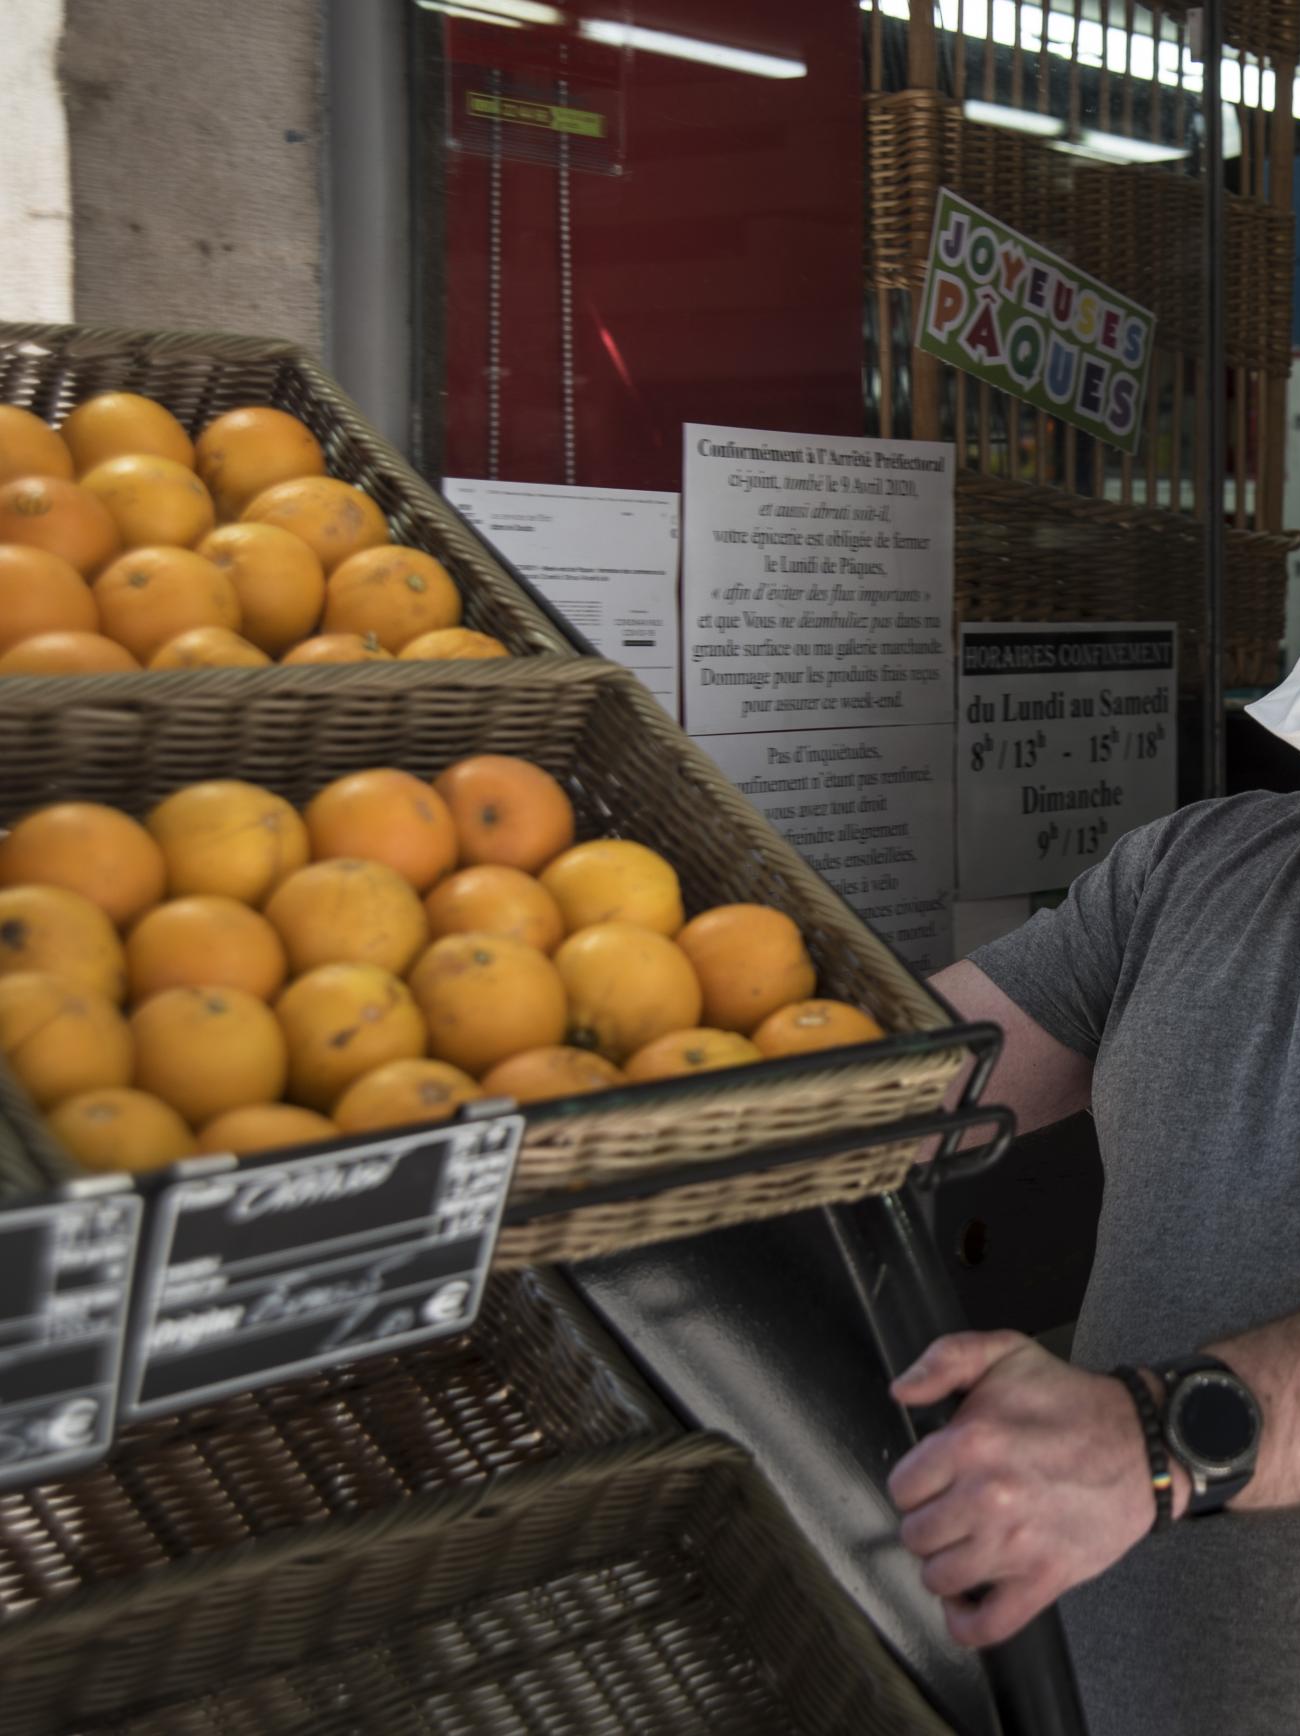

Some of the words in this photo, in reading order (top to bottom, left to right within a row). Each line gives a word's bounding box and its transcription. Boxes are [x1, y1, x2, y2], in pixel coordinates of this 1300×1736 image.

[940, 213, 1147, 367] JOYEUSES
[928, 270, 1139, 436] PÂQUES
[698, 439, 804, 464] Conformément
[807, 447, 816, 463] à
[875, 452, 945, 472] Préfectoral
[825, 475, 838, 492] le
[840, 476, 848, 493] 9
[853, 478, 883, 495] Avril
[758, 504, 772, 517] et
[712, 529, 748, 544] votre
[751, 527, 803, 549] épicerie
[804, 532, 825, 546] est
[827, 530, 872, 552] obligée
[875, 531, 892, 548] de
[893, 531, 931, 549] fermer
[764, 555, 778, 572] le
[780, 556, 818, 574] Lundi
[821, 557, 837, 574] de
[723, 582, 750, 604] afin
[807, 584, 827, 601] des
[829, 584, 855, 605] flux
[858, 587, 921, 606] importants
[697, 613, 712, 629] et
[714, 614, 740, 633] que
[742, 611, 776, 629] Vous
[779, 616, 797, 629] ne
[870, 616, 892, 633] pas
[894, 612, 921, 629] dans
[691, 639, 741, 662] grande
[743, 639, 790, 657] surface
[793, 643, 811, 656] ou
[813, 643, 834, 656] ma
[837, 638, 877, 660] galerie
[965, 645, 1056, 668] HORAIRES
[1061, 642, 1172, 666] CONFINEMENT
[700, 668, 771, 689] Dommage
[772, 671, 804, 689] pour
[806, 666, 825, 683] les
[827, 665, 878, 687] produits
[880, 665, 908, 682] frais
[910, 668, 940, 684] reçus
[741, 699, 772, 718] pour
[774, 698, 819, 712] assurer
[821, 697, 836, 710] ce
[967, 695, 994, 723] du
[1001, 691, 1064, 722] Lundi
[1070, 698, 1094, 718] au
[1100, 686, 1169, 717] Samedi
[767, 747, 791, 764] Pas
[858, 770, 877, 791] pas
[800, 803, 827, 817] avez
[830, 800, 855, 814] tout
[1022, 779, 1123, 815] Dimanche
